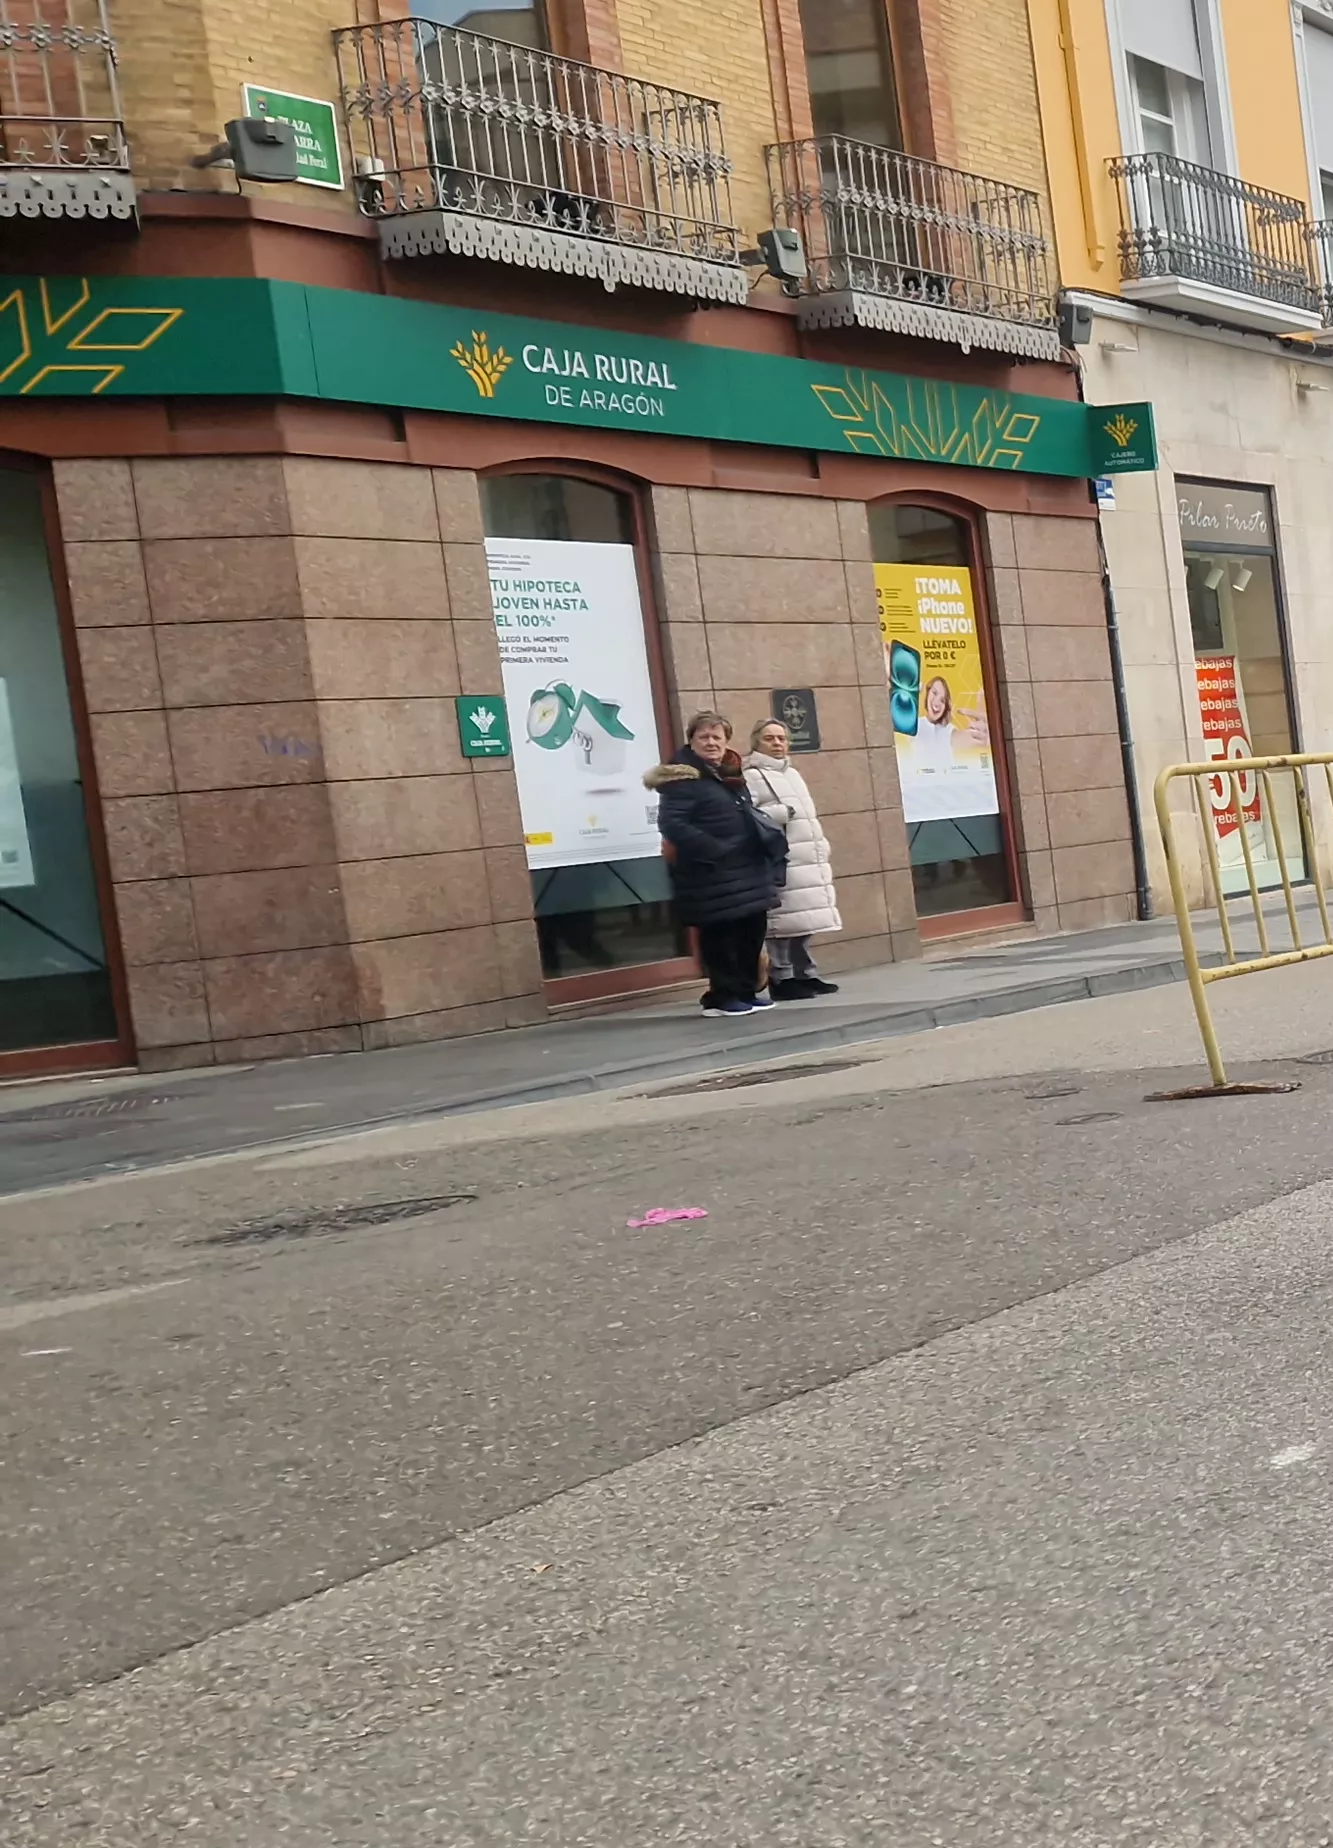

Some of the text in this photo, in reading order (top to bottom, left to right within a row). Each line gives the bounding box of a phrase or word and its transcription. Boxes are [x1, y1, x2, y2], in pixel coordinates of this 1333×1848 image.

[522, 344, 678, 390] CAJA RURAL
[544, 384, 665, 417] DE ARAGÓN
[1178, 499, 1220, 529] Pilar
[489, 579, 581, 593] TU HIPOTECA
[493, 597, 589, 611] JOVEN HASTA
[917, 597, 965, 615] iPhone
[495, 614, 513, 627] EL
[920, 617, 974, 634] NUEVO!
[924, 651, 941, 660] POR
[1195, 657, 1233, 672] ebajas
[1197, 677, 1236, 693] ebajas
[1200, 698, 1239, 713] ebajas
[1205, 735, 1257, 810] 50
[1214, 810, 1256, 825] rebaas
